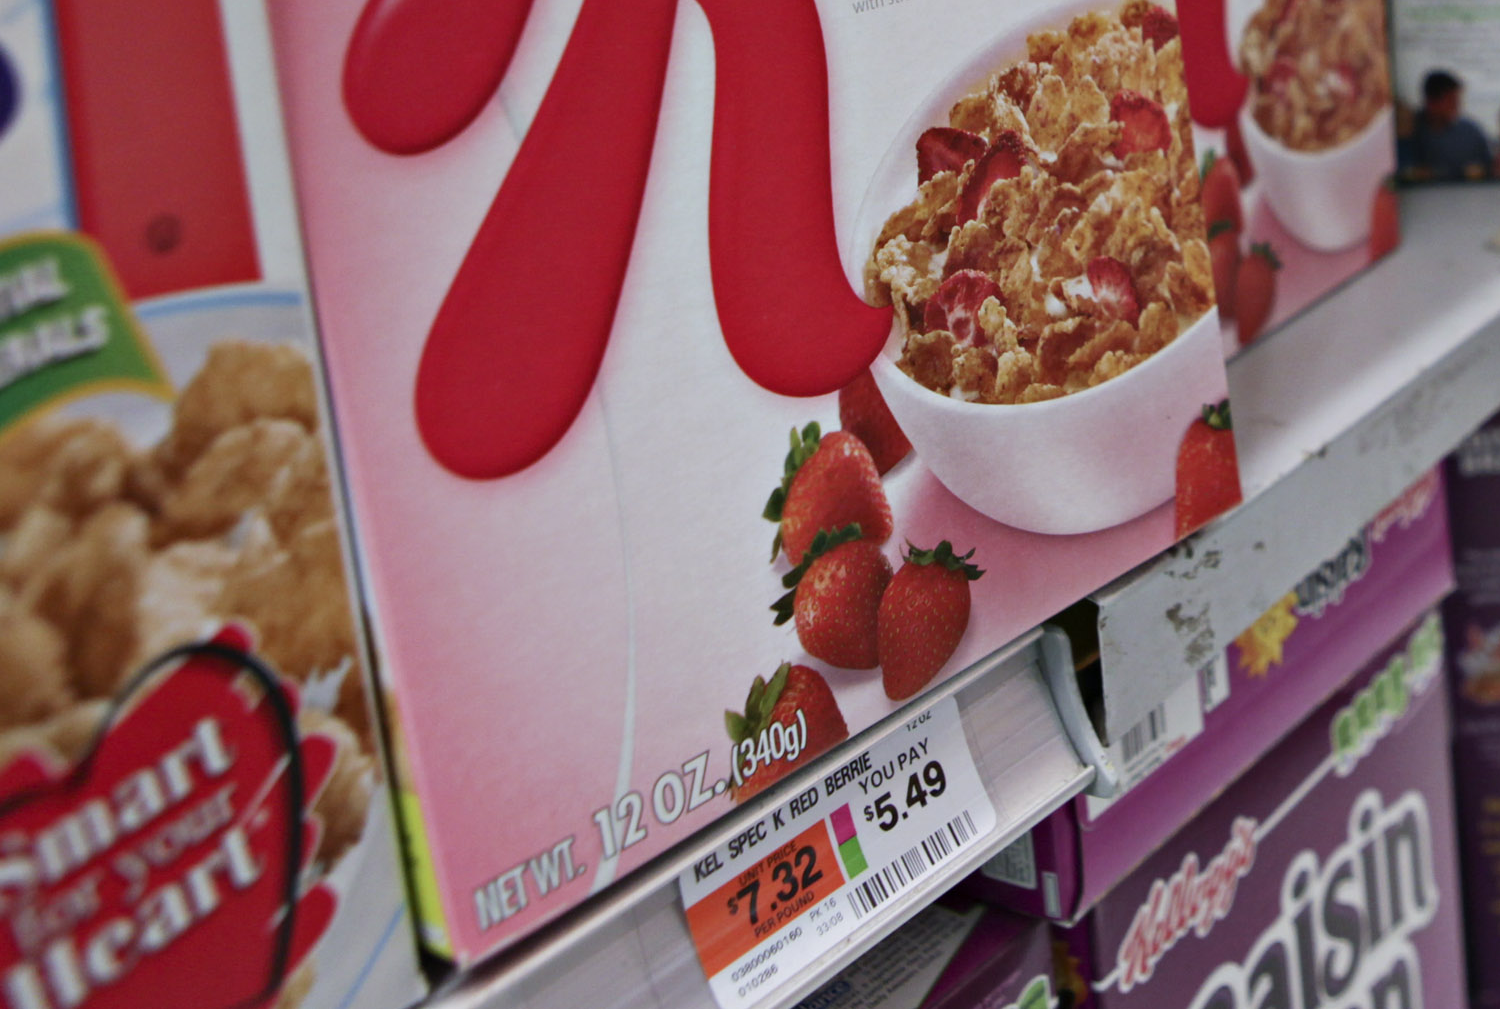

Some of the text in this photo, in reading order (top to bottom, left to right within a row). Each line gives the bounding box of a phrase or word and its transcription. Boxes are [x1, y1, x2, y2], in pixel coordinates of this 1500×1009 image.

[0, 718, 235, 891] Smart
[858, 737, 929, 795] YOU PAY
[863, 760, 947, 832] $5.49
[474, 709, 807, 931] NET WT. 12 OZ. (340g)
[694, 751, 872, 883] KEL SPEC K RED BERRIE
[727, 845, 823, 925] $7.32
[738, 840, 798, 887] UNIT PRICE
[1197, 796, 1433, 1009] aisin
[754, 891, 815, 938] PER POUND
[809, 908, 822, 922] PK
[824, 897, 837, 911] 16
[1119, 819, 1258, 991] Kellogg's
